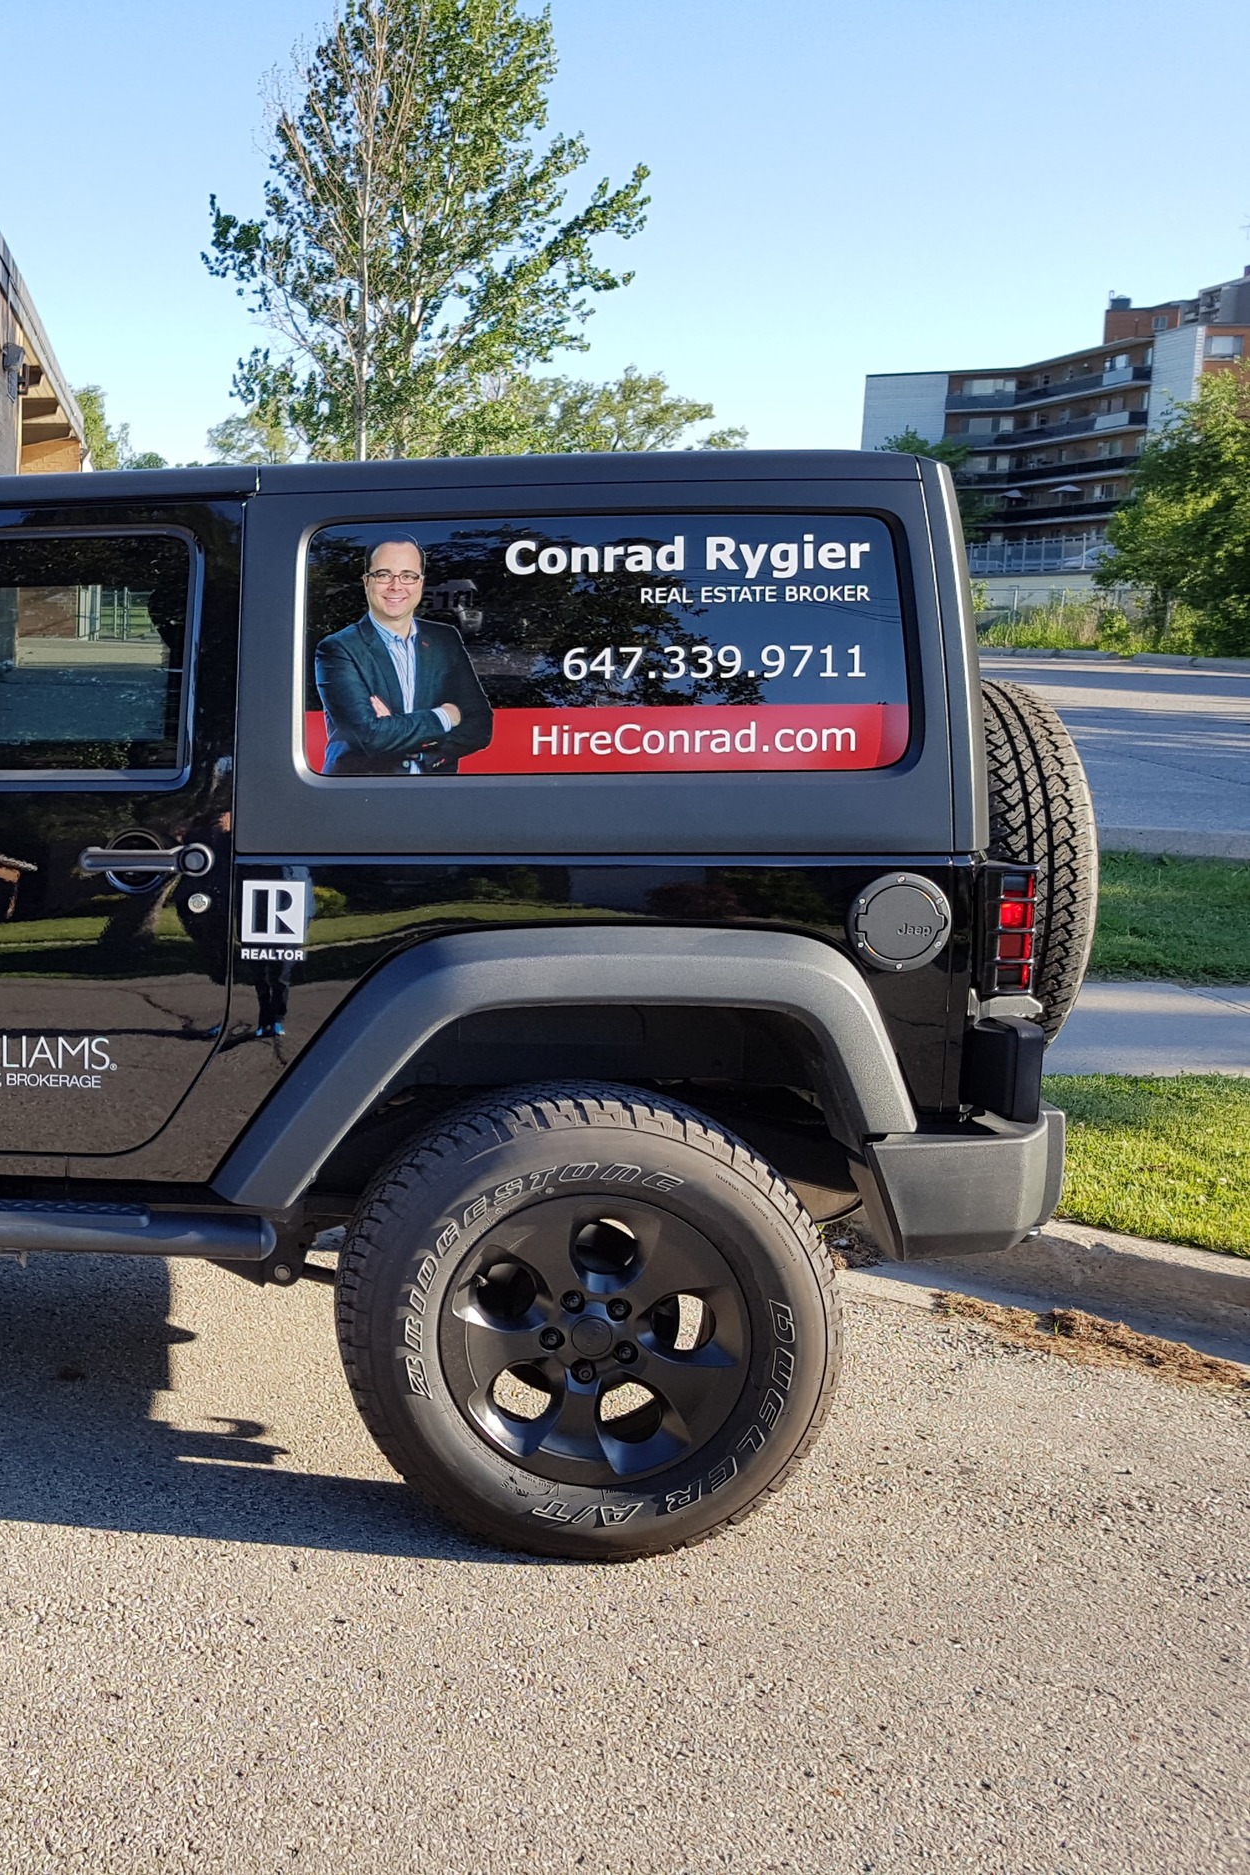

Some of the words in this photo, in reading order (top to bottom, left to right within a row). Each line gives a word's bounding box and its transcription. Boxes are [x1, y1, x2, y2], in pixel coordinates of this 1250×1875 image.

[505, 535, 685, 576] Conrad
[706, 533, 870, 578] Rygier
[640, 587, 693, 604] REAL
[700, 586, 777, 603] ESTATE
[784, 585, 870, 602] BROKER
[563, 644, 867, 681] 647.339.9711
[531, 722, 857, 756] HireConrad.com
[896, 923, 932, 937] Jeep
[241, 948, 304, 961] REALTOR
[6, 1073, 102, 1089] BROKERAGE
[405, 1162, 685, 1401] BRIDGESTONE
[664, 1299, 796, 1514] DUELER
